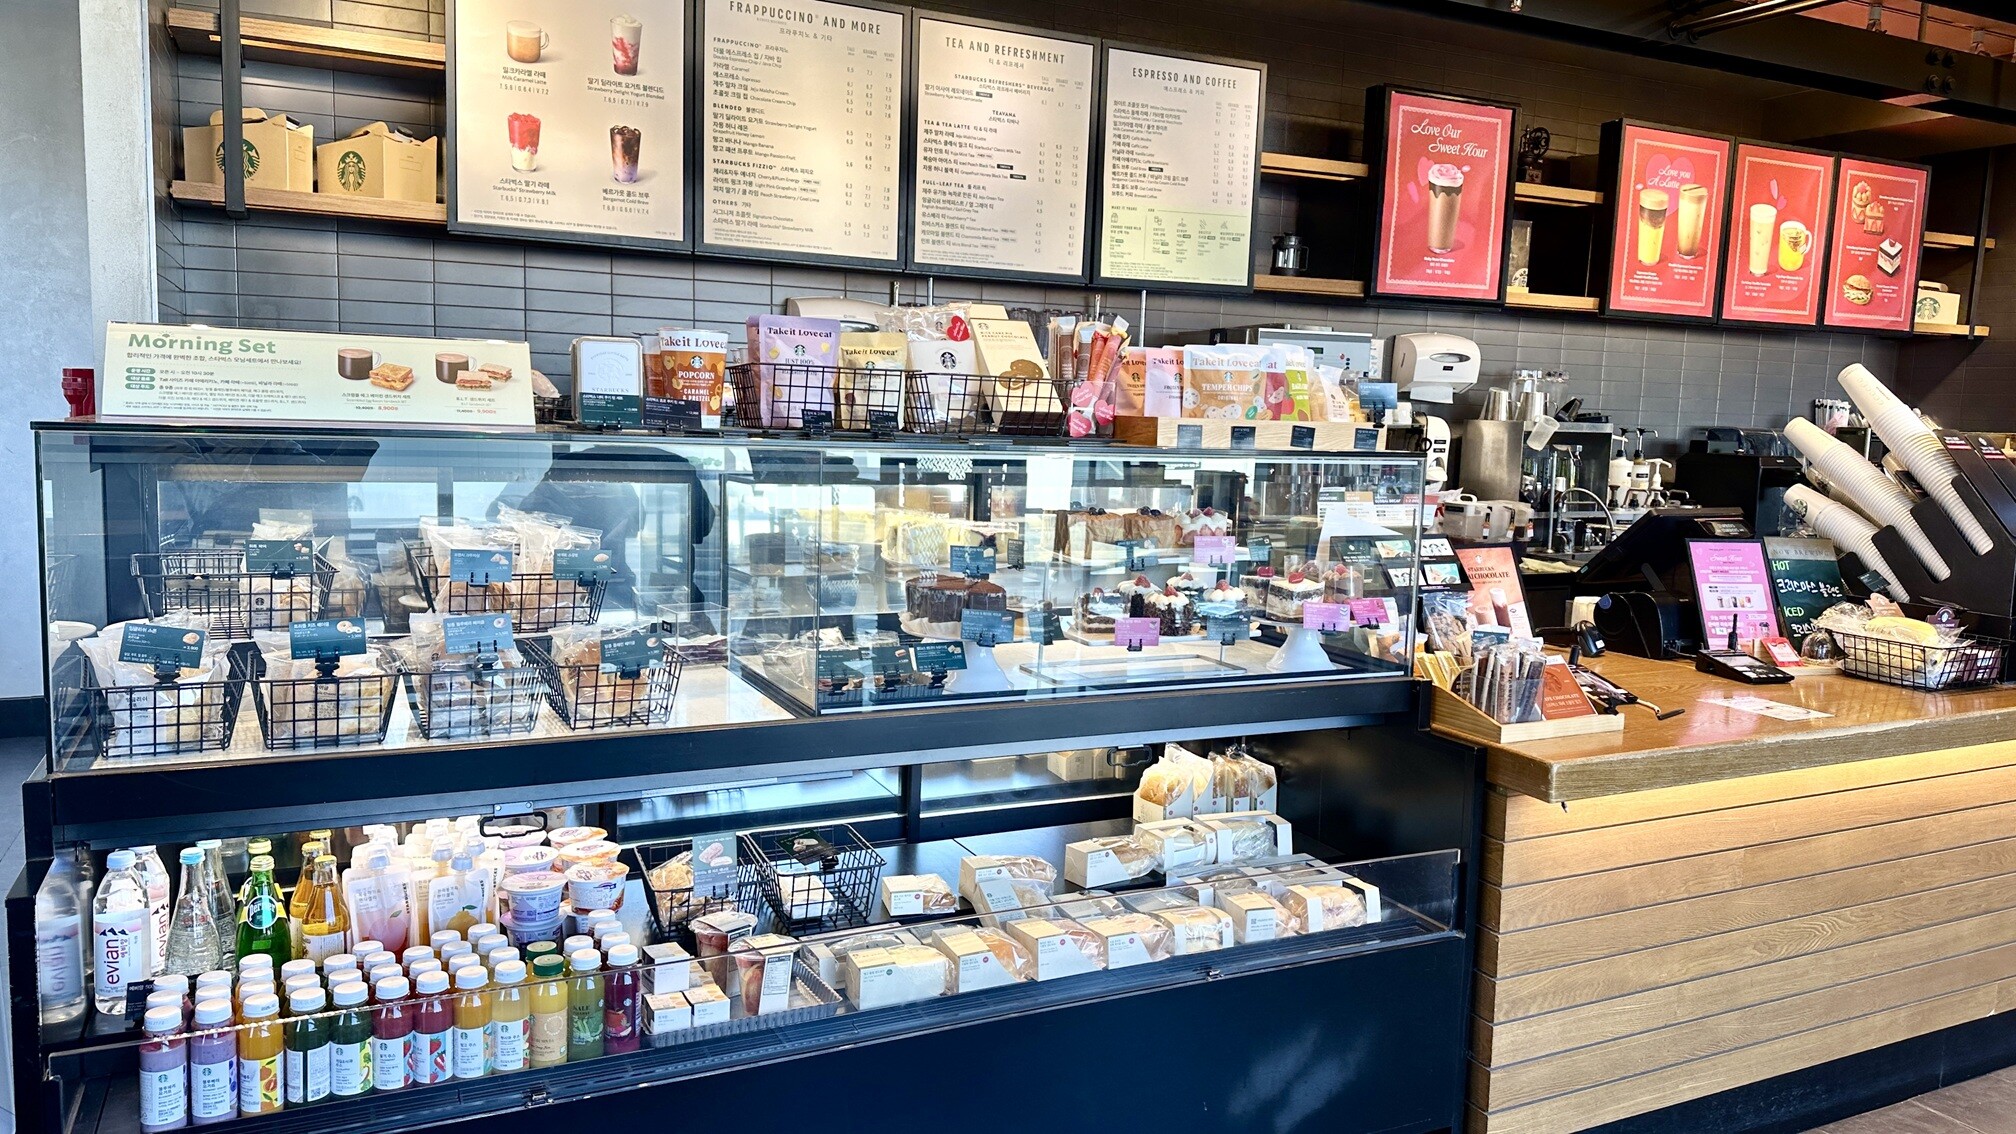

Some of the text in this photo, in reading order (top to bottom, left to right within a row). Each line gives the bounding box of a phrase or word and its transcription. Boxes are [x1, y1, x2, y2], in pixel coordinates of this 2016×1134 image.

[823, 16, 846, 29] AND
[851, 22, 881, 34] MORE
[779, 27, 810, 38] 프라푸치노
[821, 34, 833, 42] 기타
[946, 37, 1065, 64] TEA AND REFRESHMENT
[955, 74, 987, 83] STARBUCKS
[1027, 82, 1054, 92] BEVERAGE
[1133, 68, 1237, 89] ESPRESSO AND COFFEE
[713, 103, 742, 111] BLENDED
[992, 110, 1016, 118] TEAVANA
[954, 122, 970, 130] LATTE
[1411, 119, 1462, 138] Love Our
[1428, 138, 1489, 158] Sweet Hour
[713, 158, 750, 167] STARBUCKS
[1658, 165, 1691, 179] Love you
[499, 178, 522, 186] 스타벅스
[922, 180, 952, 188] FULL-LEAF
[1660, 177, 1680, 188] Latte
[713, 199, 738, 207] OTHERS
[128, 331, 276, 354] Morning Set
[678, 371, 715, 379] POPCORN
[1202, 384, 1253, 392] TEMPER CHIPS
[1772, 561, 1790, 570] HOT
[1777, 579, 1818, 593] 크리스마스
[1784, 606, 1804, 617] ICED
[104, 939, 120, 985] evian
